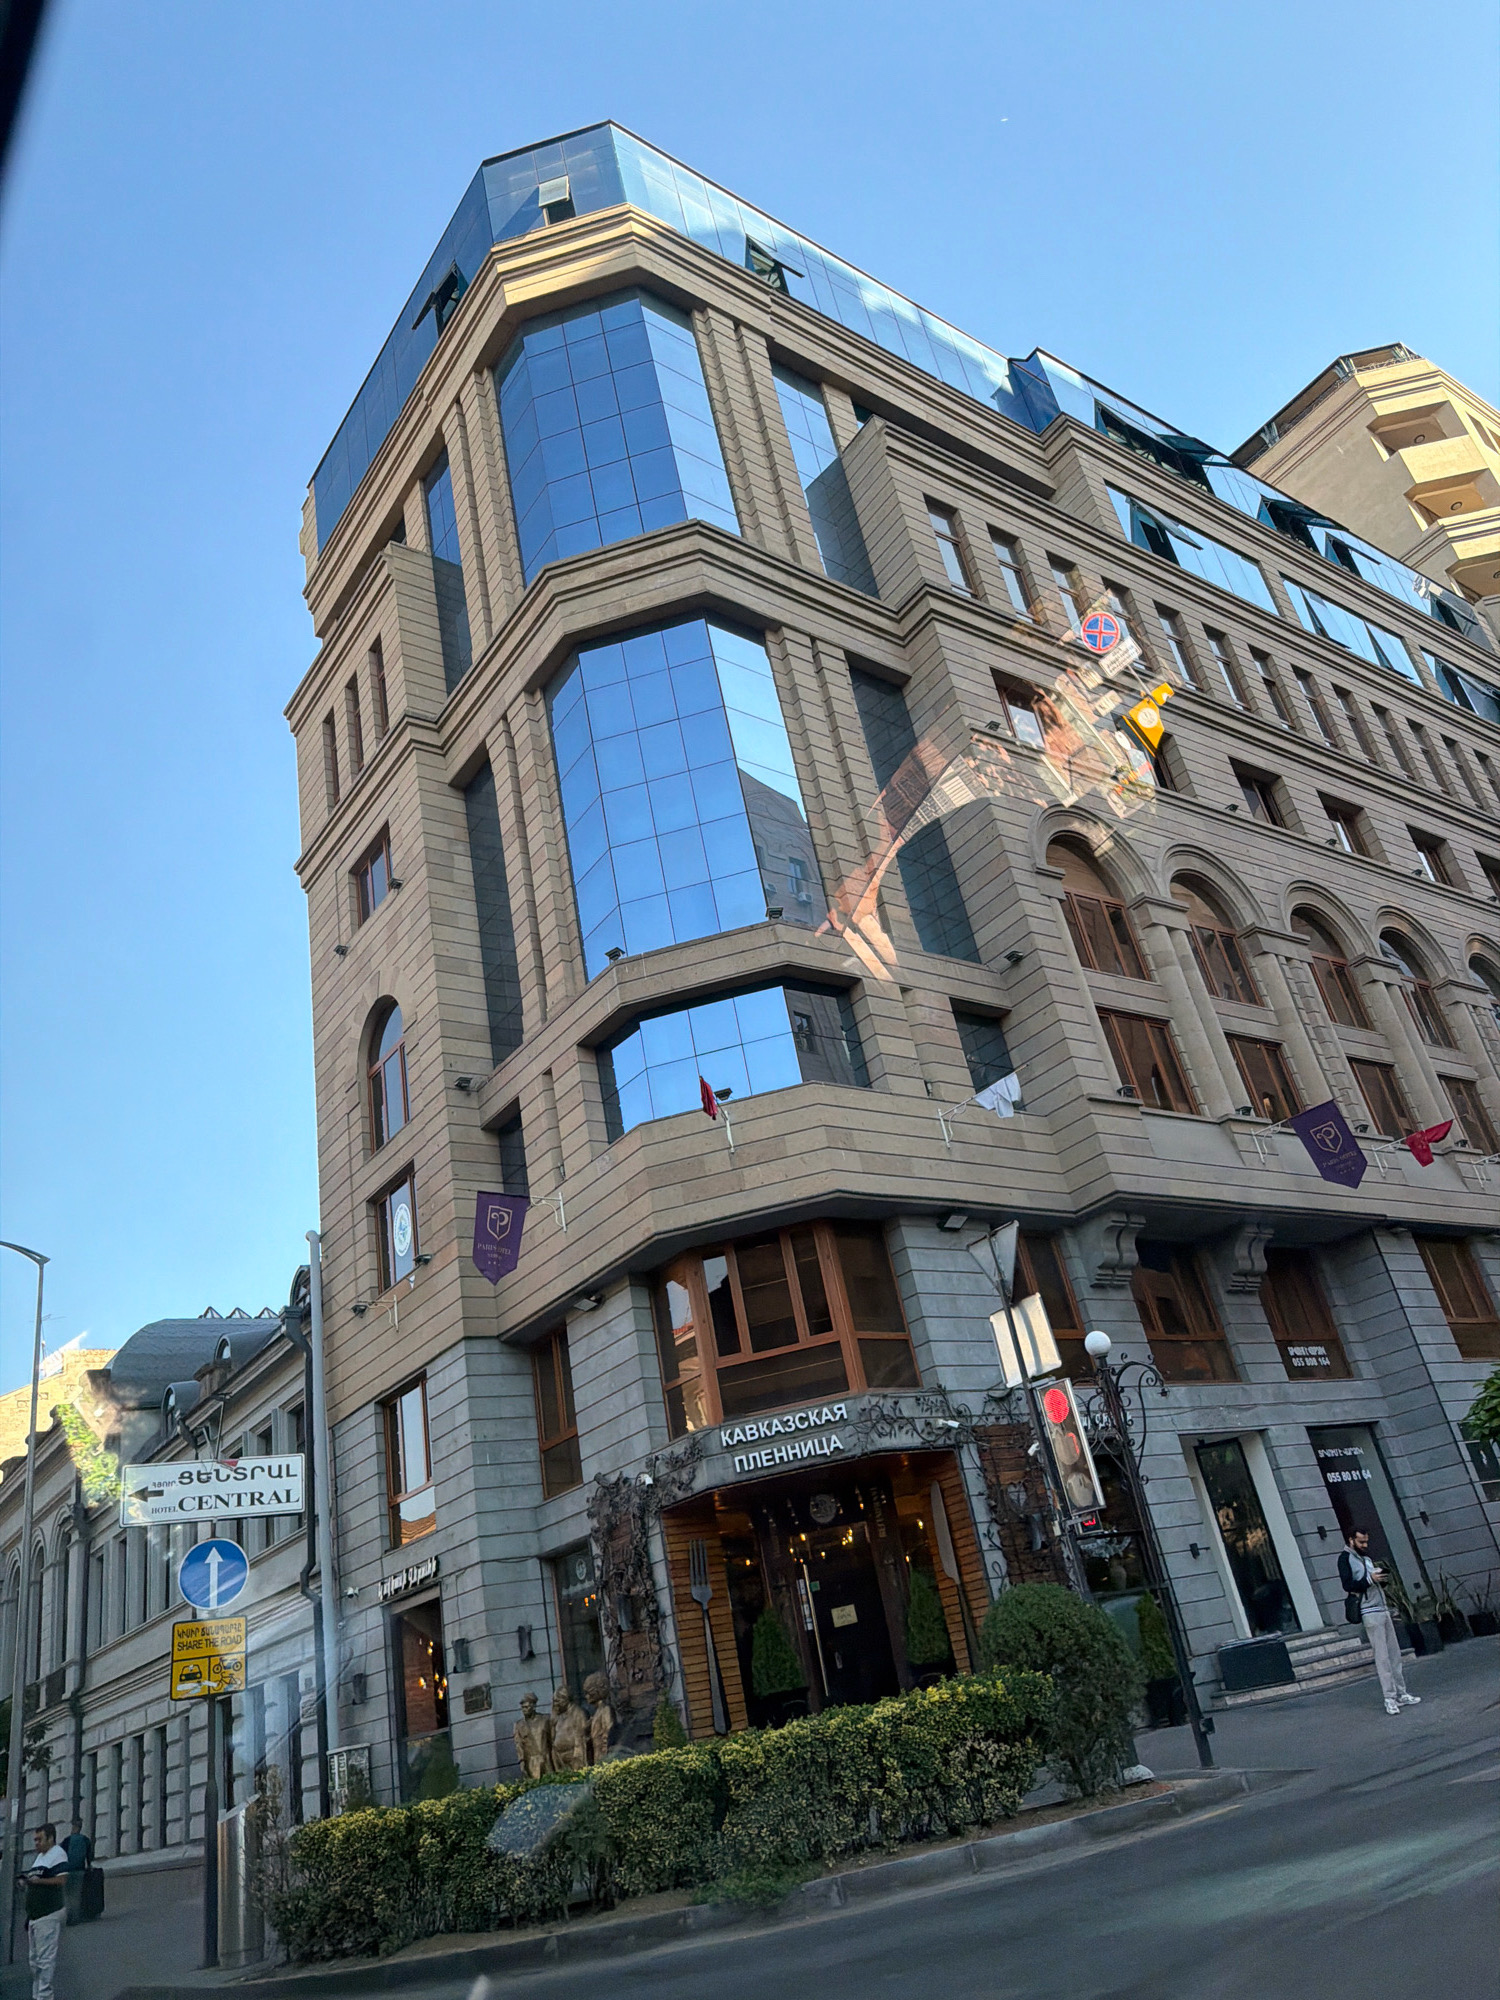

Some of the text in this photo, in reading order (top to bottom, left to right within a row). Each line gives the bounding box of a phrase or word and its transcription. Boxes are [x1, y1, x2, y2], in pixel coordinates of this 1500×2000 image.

[1292, 1357, 1305, 1367] 055
[721, 1403, 848, 1447] КАВКАЗСКАЯ
[734, 1434, 844, 1473] ПЛЕННИЦА
[1326, 1469, 1372, 1483] 055 80 81 64
[151, 1489, 300, 1515] HOTEL CENTRAL
[177, 1634, 242, 1652] SHARE THE ROAD
